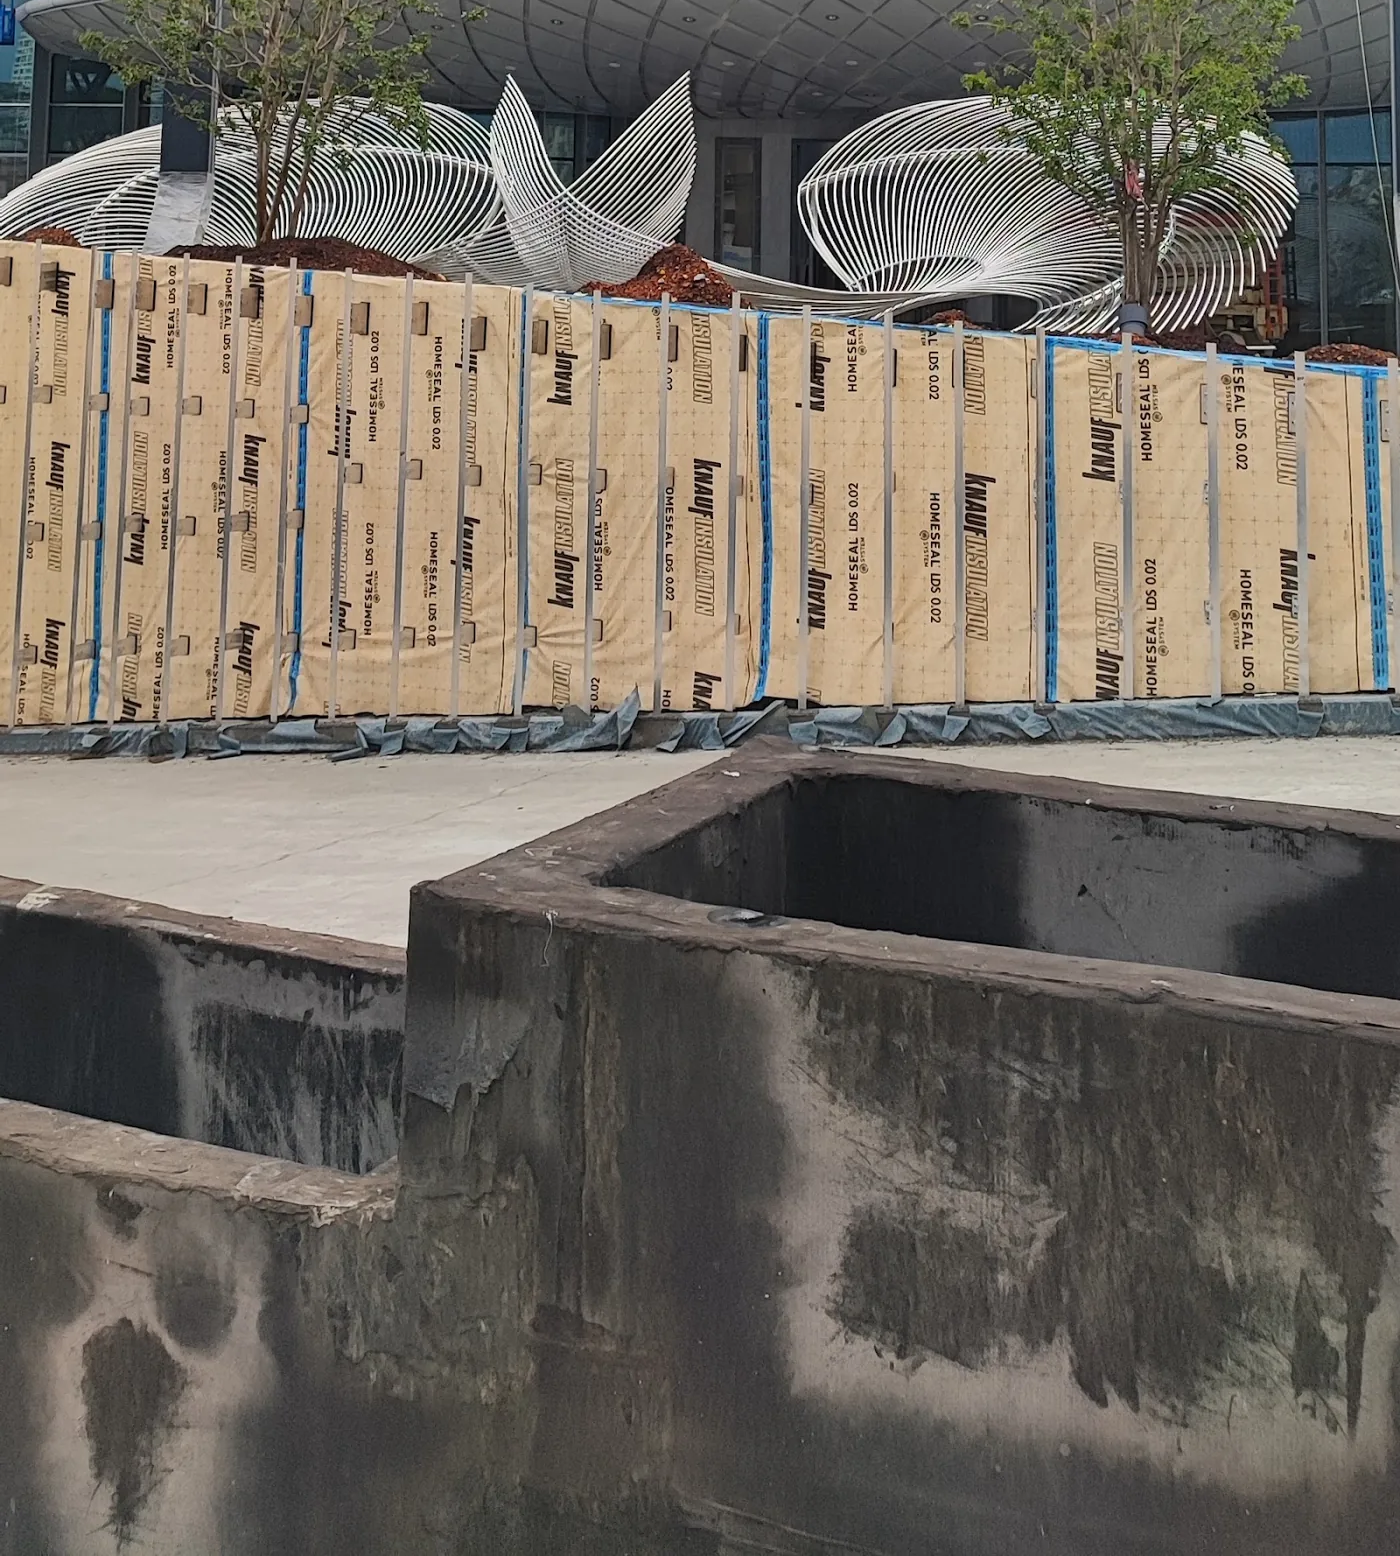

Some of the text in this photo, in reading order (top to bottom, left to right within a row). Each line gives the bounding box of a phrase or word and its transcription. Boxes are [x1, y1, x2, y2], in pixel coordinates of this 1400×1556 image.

[166, 265, 177, 368] HOMESEAL LDS 0.02
[222, 269, 232, 374] HOMESEAL LDS 0.02
[691, 313, 712, 404] NSULATION
[928, 351, 938, 371] LDS
[368, 331, 379, 442] HOMESEAL LDS 0.02
[432, 337, 442, 450] HOMESEAL LDS 0.02
[929, 375, 939, 400] 0.02
[1139, 358, 1150, 379] LDS
[1141, 384, 1152, 461] HOMESEAL
[1235, 418, 1247, 440] LDS
[1236, 443, 1248, 470] 0.02
[161, 443, 171, 549] HOMESEAL LDS 0.02
[218, 451, 226, 513] HOMESEAL
[554, 458, 575, 552] INSULATION
[364, 522, 374, 636] HOMESEAL LDS 0.02
[427, 532, 438, 647] HOMESEAL LDS 0.02
[594, 521, 603, 591] HOMESEAL
[665, 486, 674, 601] OMESEAL LDS 0.02
[694, 517, 714, 616] INSULATION
[848, 482, 859, 611] HOMESEAL LDS 0.02
[930, 492, 941, 624] HOMESEAL LDS 0.02
[965, 535, 988, 641] INSULATION
[1093, 542, 1119, 650] INSULATION
[1144, 558, 1157, 696] HOMESEAL LDS 0.02
[1240, 569, 1253, 650] HOMESEAL
[18, 633, 30, 694] HOSEAL
[155, 651, 163, 669] LDS
[1242, 656, 1254, 678] LDS
